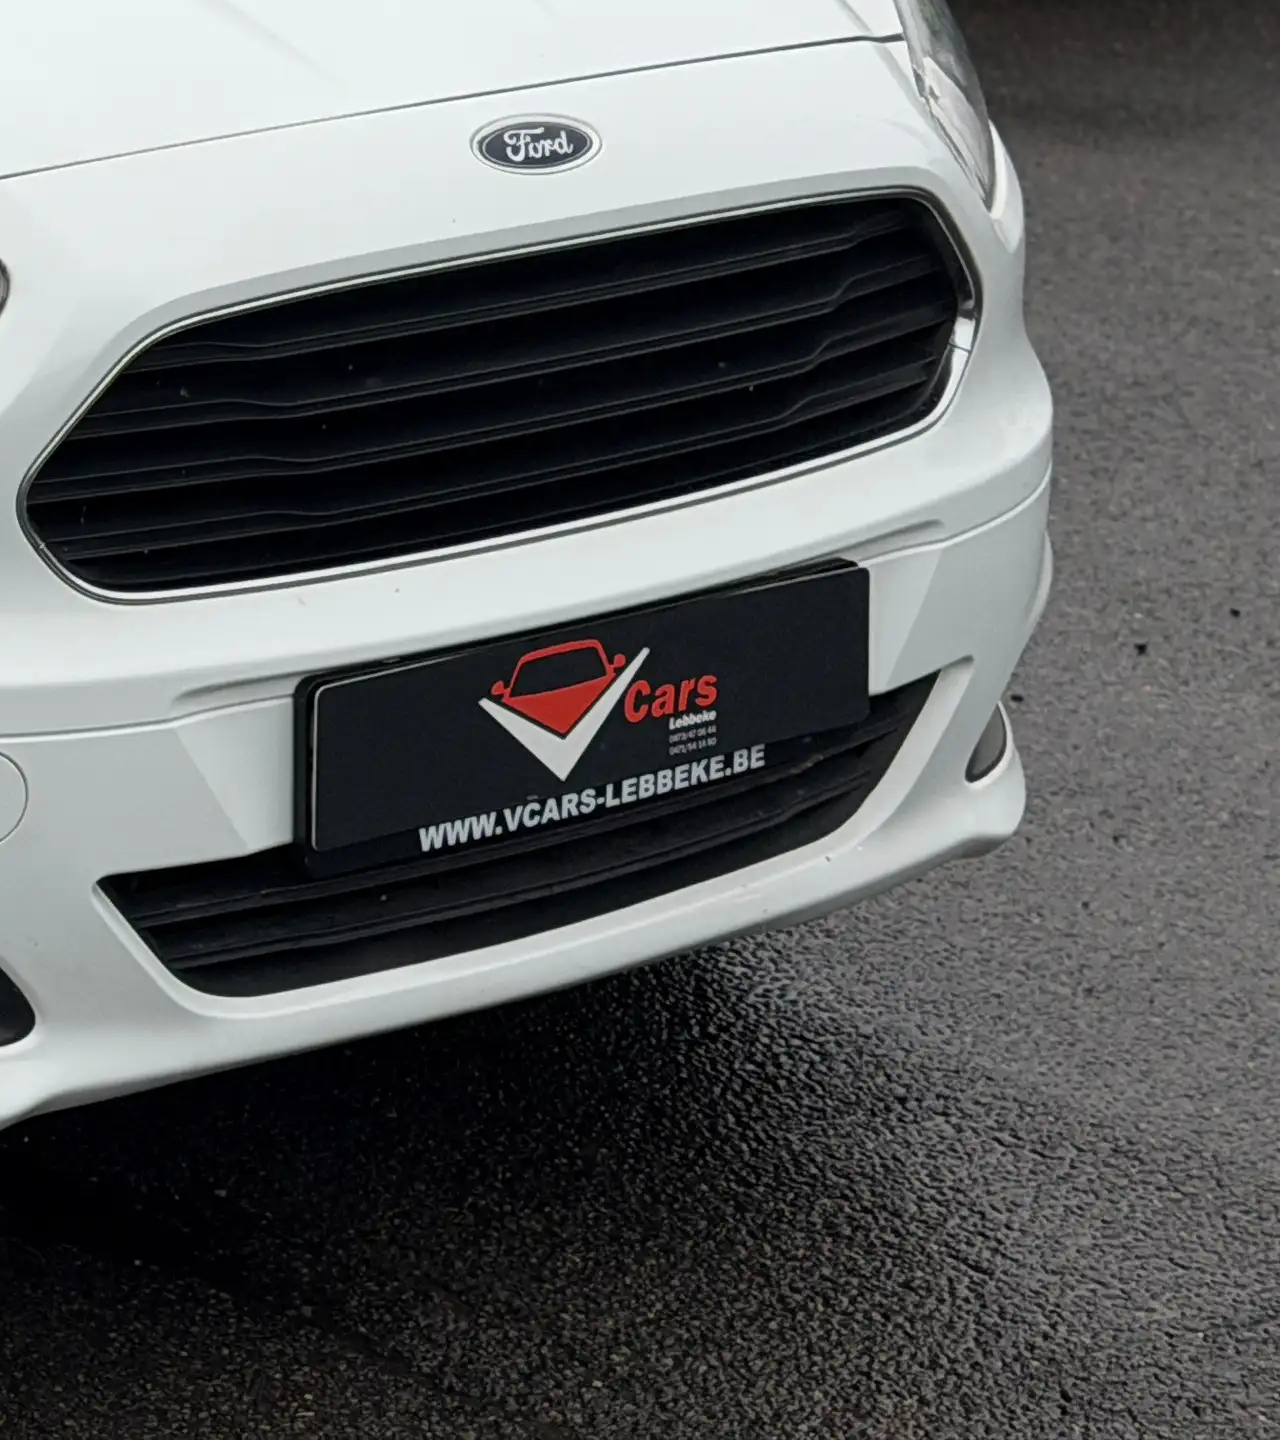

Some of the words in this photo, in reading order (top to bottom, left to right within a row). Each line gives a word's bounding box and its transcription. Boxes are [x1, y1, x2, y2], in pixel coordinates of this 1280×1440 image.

[503, 126, 574, 162] Ford
[624, 674, 718, 723] Cars
[668, 710, 717, 731] Lebbeke
[418, 743, 767, 852] WWW.VCARS-LEBBEKE.BE
